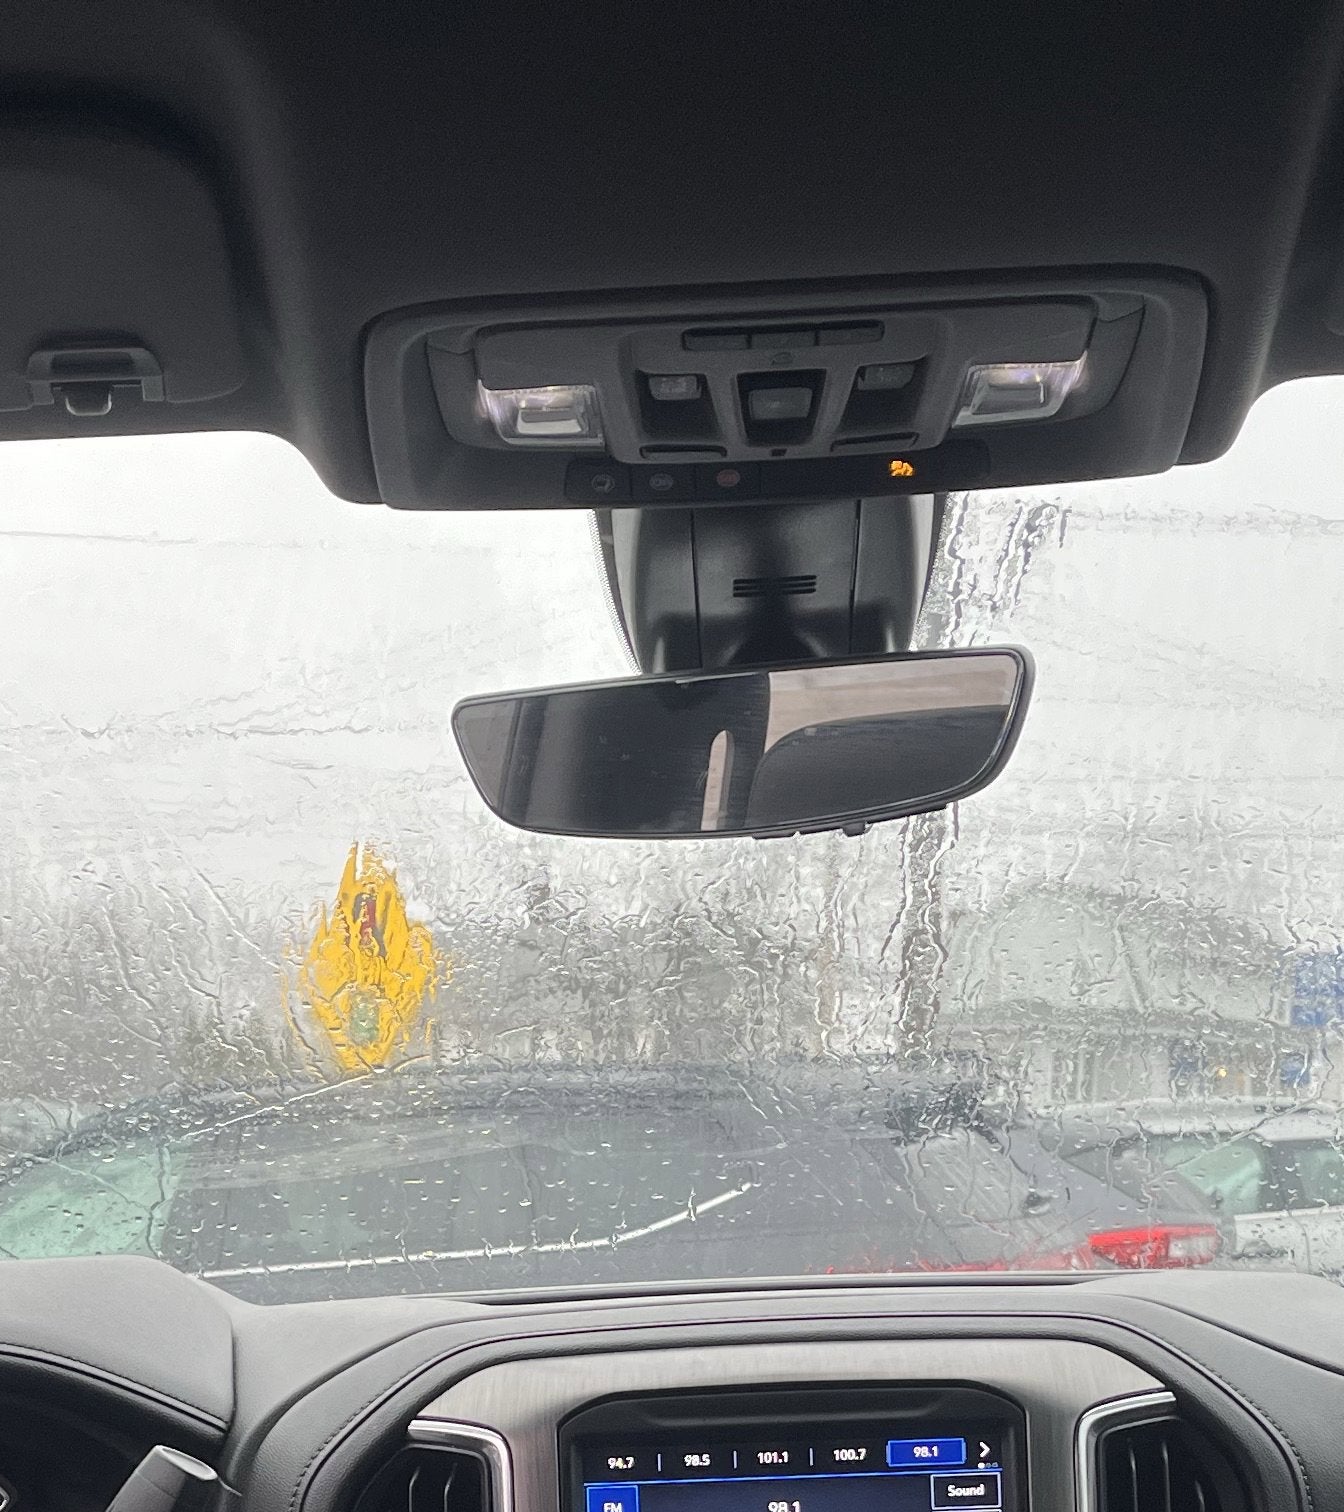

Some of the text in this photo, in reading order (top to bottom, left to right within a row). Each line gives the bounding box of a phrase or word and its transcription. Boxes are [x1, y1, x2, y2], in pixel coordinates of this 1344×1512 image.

[757, 1451, 789, 1464] 101.1
[833, 1448, 867, 1461] 100.7
[913, 1446, 939, 1458] 98.1
[947, 1483, 985, 1497] Sound
